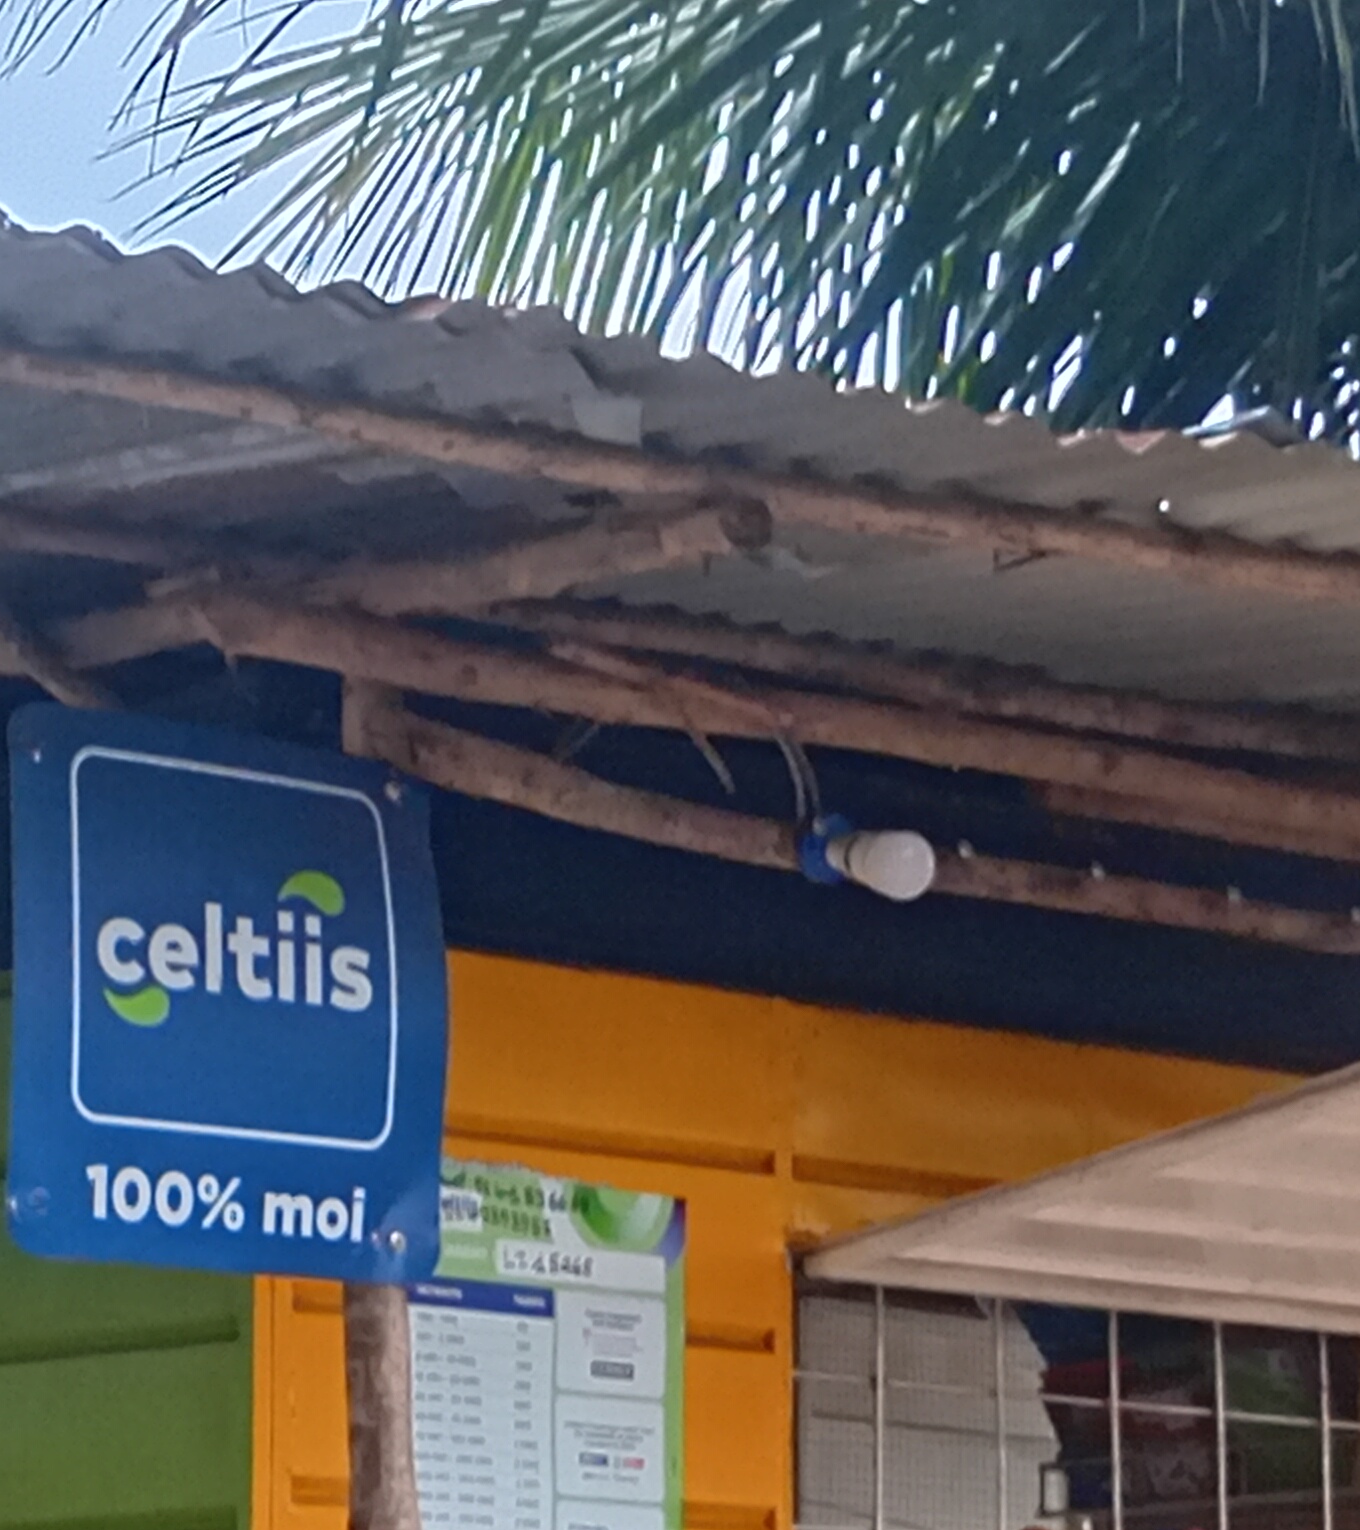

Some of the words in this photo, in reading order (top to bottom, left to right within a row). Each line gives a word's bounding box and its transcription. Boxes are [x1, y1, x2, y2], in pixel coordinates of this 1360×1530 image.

[96, 901, 373, 1011] celtiis
[85, 1163, 246, 1232] 100%
[262, 1186, 367, 1243] moi
